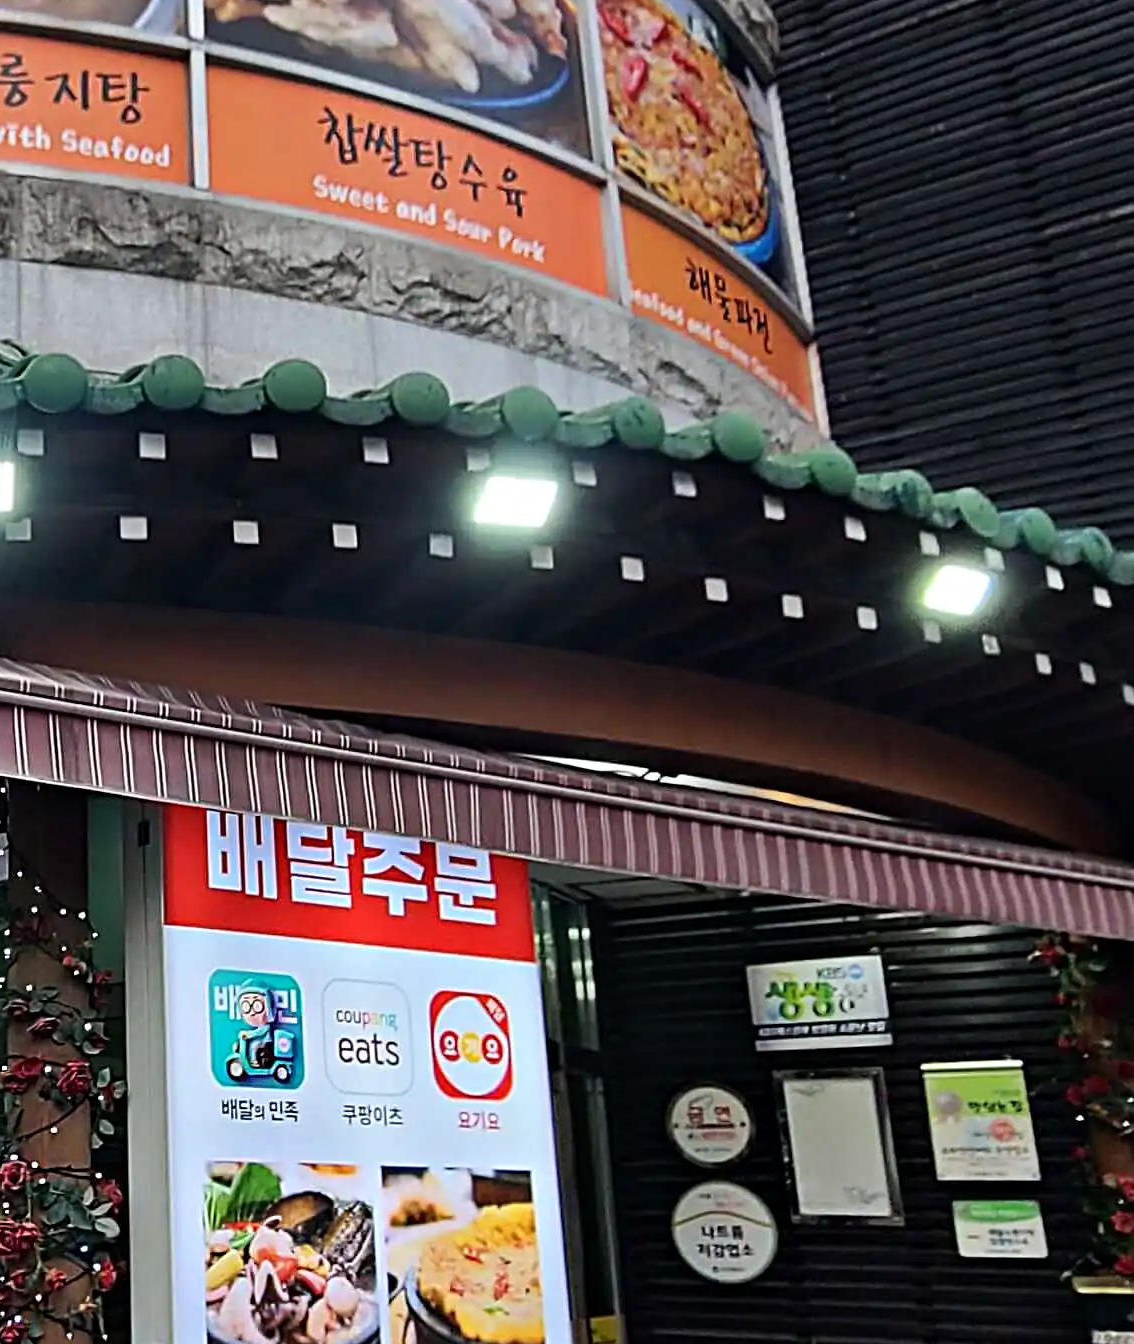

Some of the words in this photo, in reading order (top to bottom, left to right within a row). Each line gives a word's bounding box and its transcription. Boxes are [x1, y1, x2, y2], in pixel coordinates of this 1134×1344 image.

[59, 129, 171, 168] Seafood
[315, 107, 528, 218] 찹쌀탕수육
[312, 174, 390, 214] Sweet
[396, 199, 437, 227] and
[443, 208, 493, 244] Sour
[685, 257, 773, 355] 해물파전
[206, 810, 498, 926] 배달주문
[335, 1007, 398, 1031] coupang
[338, 1032, 401, 1066] eats
[342, 1105, 404, 1127] 쿠팡이츠
[457, 1111, 501, 1130] 요기요
